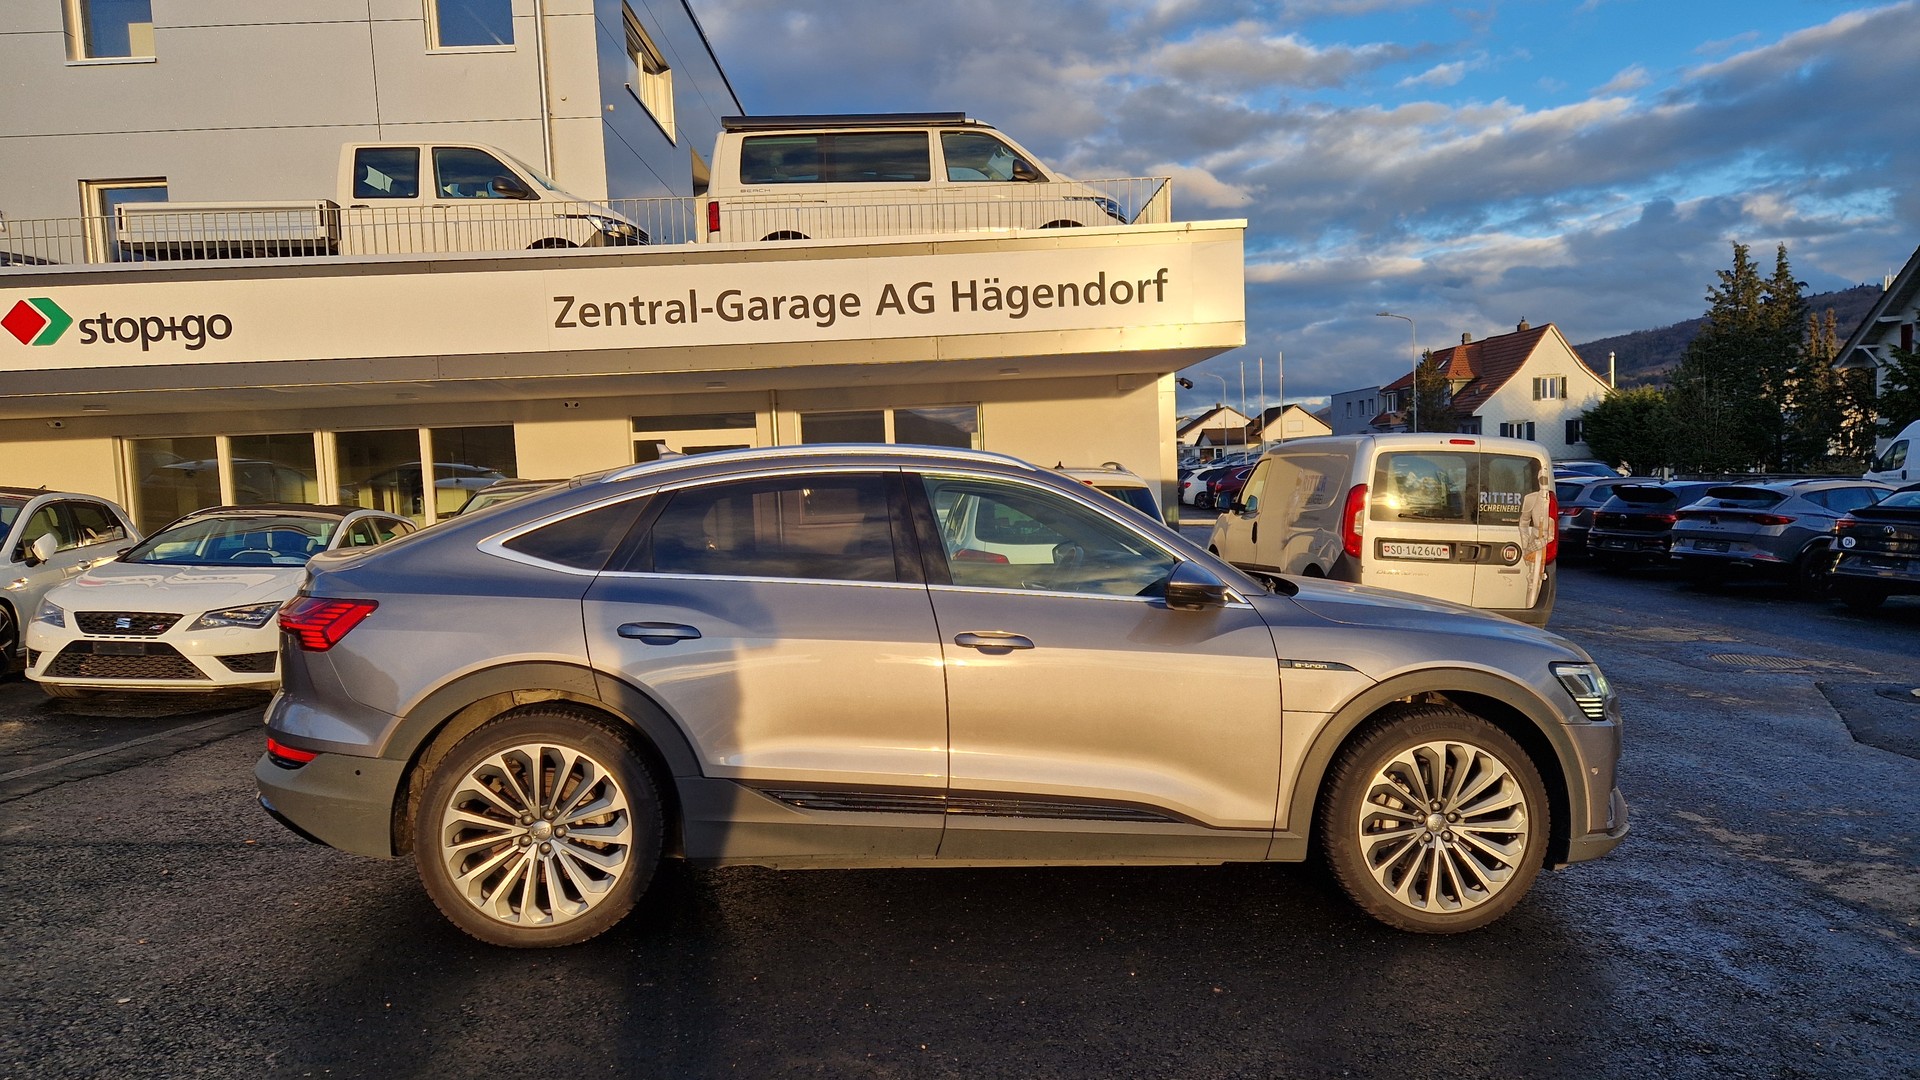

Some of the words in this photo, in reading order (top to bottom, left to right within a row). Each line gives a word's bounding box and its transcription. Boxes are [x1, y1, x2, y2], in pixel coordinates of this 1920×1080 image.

[553, 289, 861, 329] Zentral-Garage
[875, 281, 935, 316] AG
[951, 267, 1169, 319] Hägendorf
[78, 311, 233, 352] stop+go
[1479, 503, 1521, 513] SCHREINEREI
[1844, 538, 1853, 546] CH
